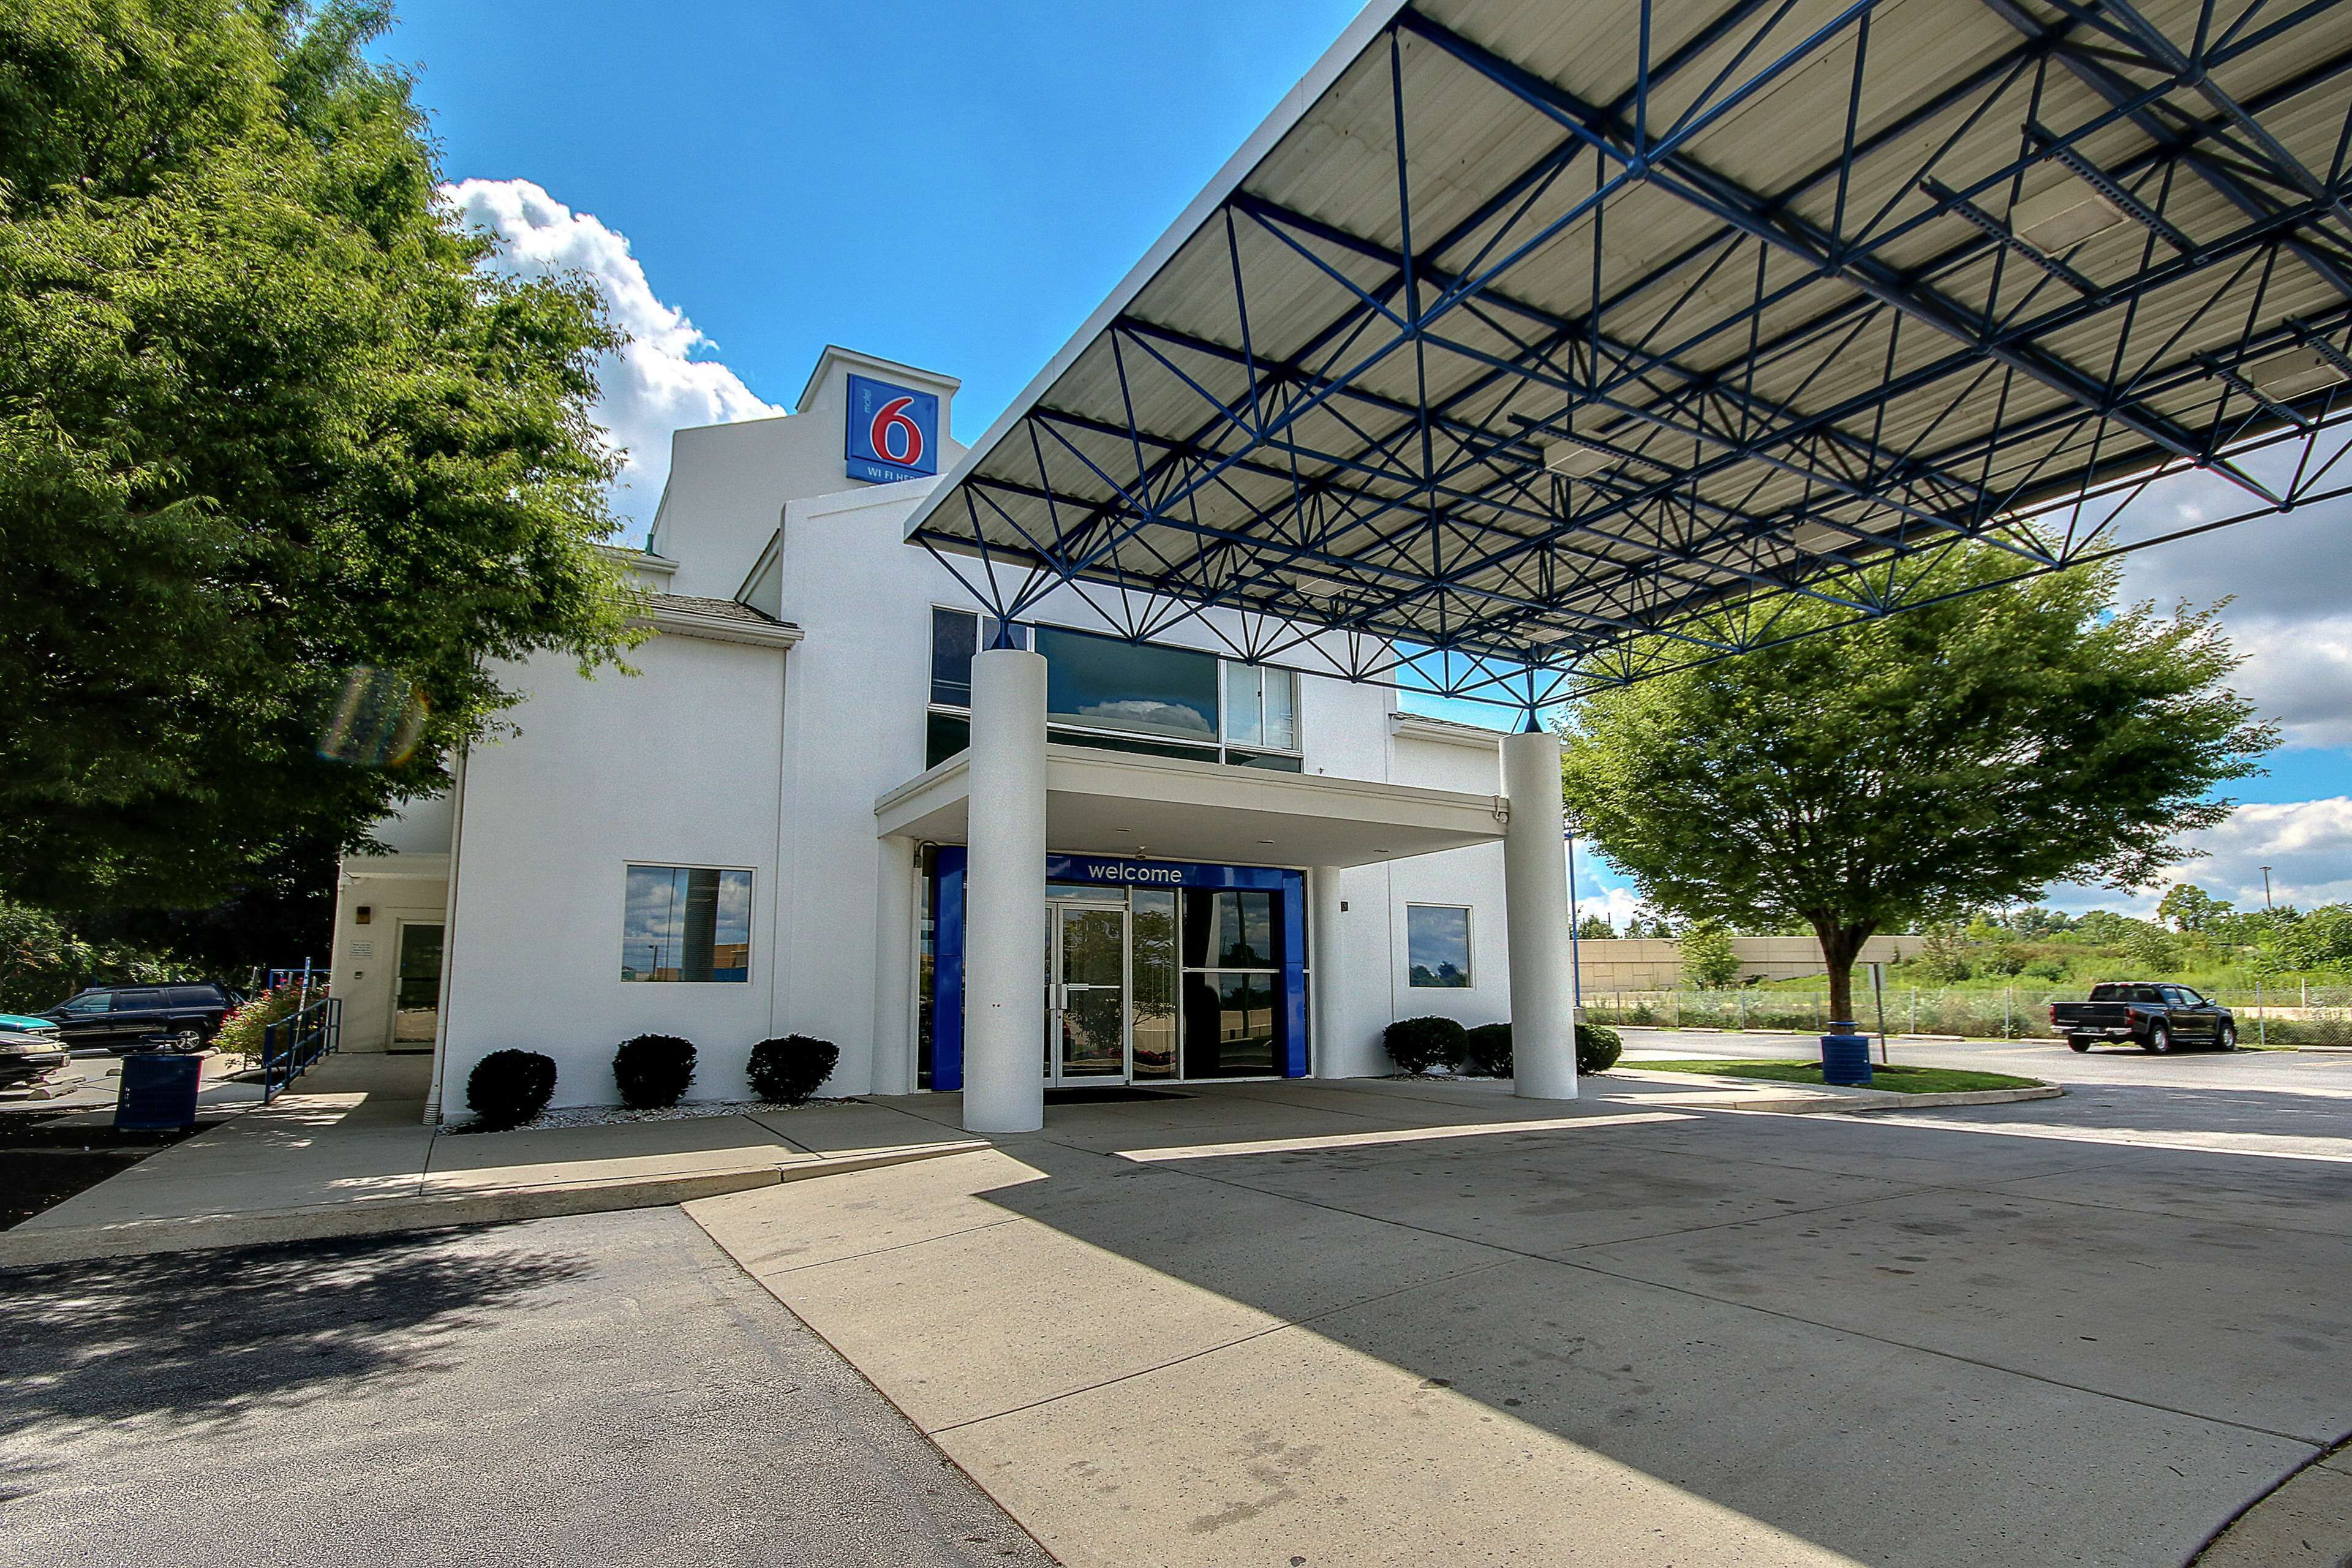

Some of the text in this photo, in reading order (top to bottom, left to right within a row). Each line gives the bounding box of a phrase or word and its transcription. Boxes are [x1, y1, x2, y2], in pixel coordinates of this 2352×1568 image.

[870, 396, 924, 466] 6
[867, 467, 881, 477] WI
[884, 470, 893, 480] FI
[1088, 862, 1182, 883] welcome
